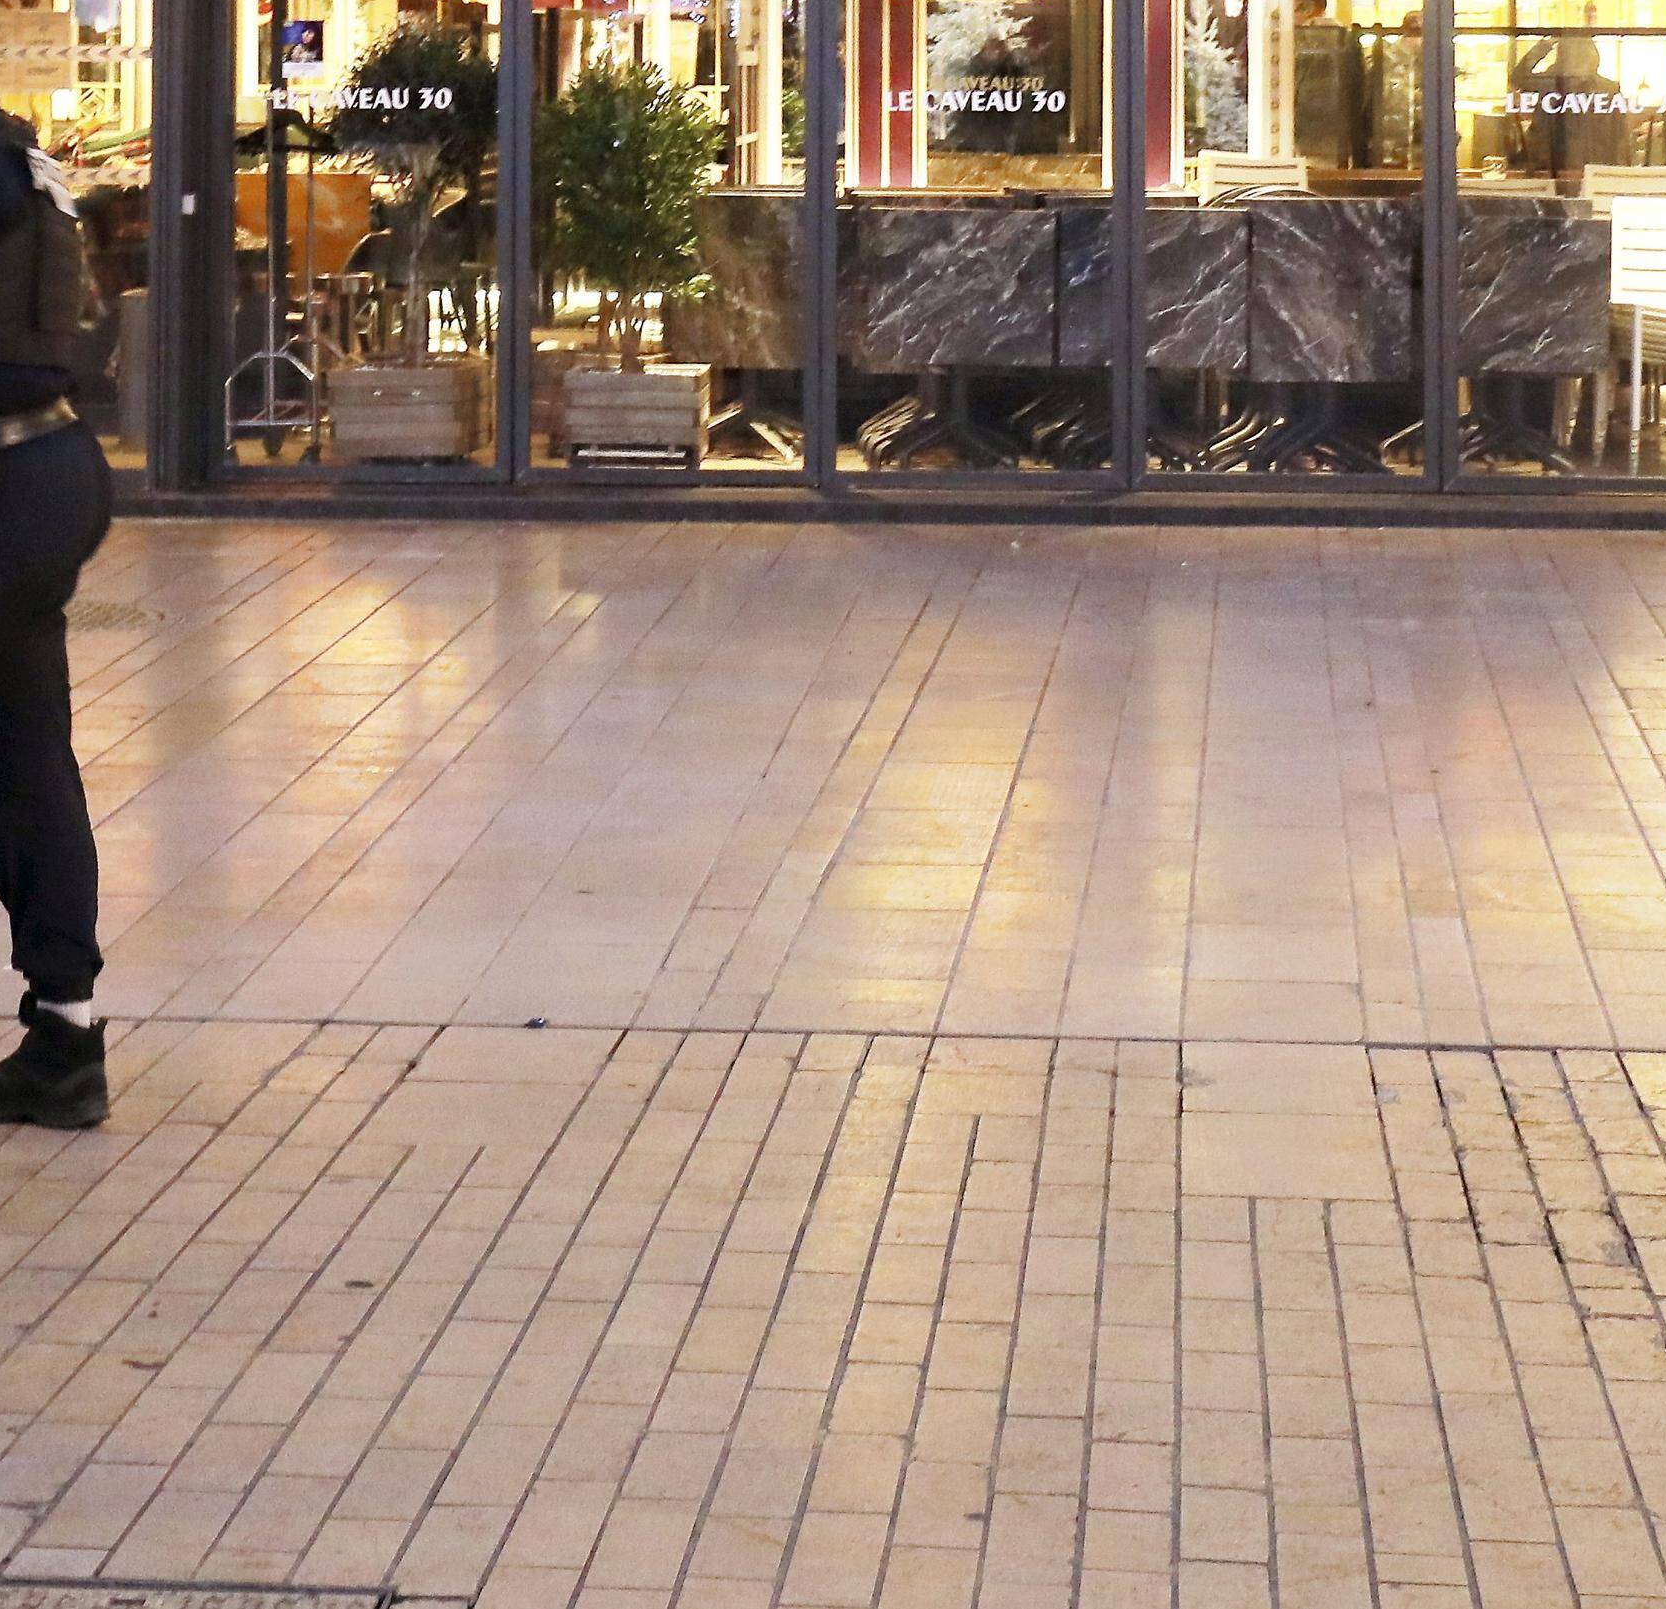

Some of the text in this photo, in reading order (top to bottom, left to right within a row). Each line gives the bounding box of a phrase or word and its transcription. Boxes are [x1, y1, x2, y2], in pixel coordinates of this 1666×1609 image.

[417, 87, 453, 109] 30
[886, 90, 1066, 113] LE CAVEAU 30
[1505, 92, 1539, 113] LE
[1541, 92, 1645, 114] CAVEAU
